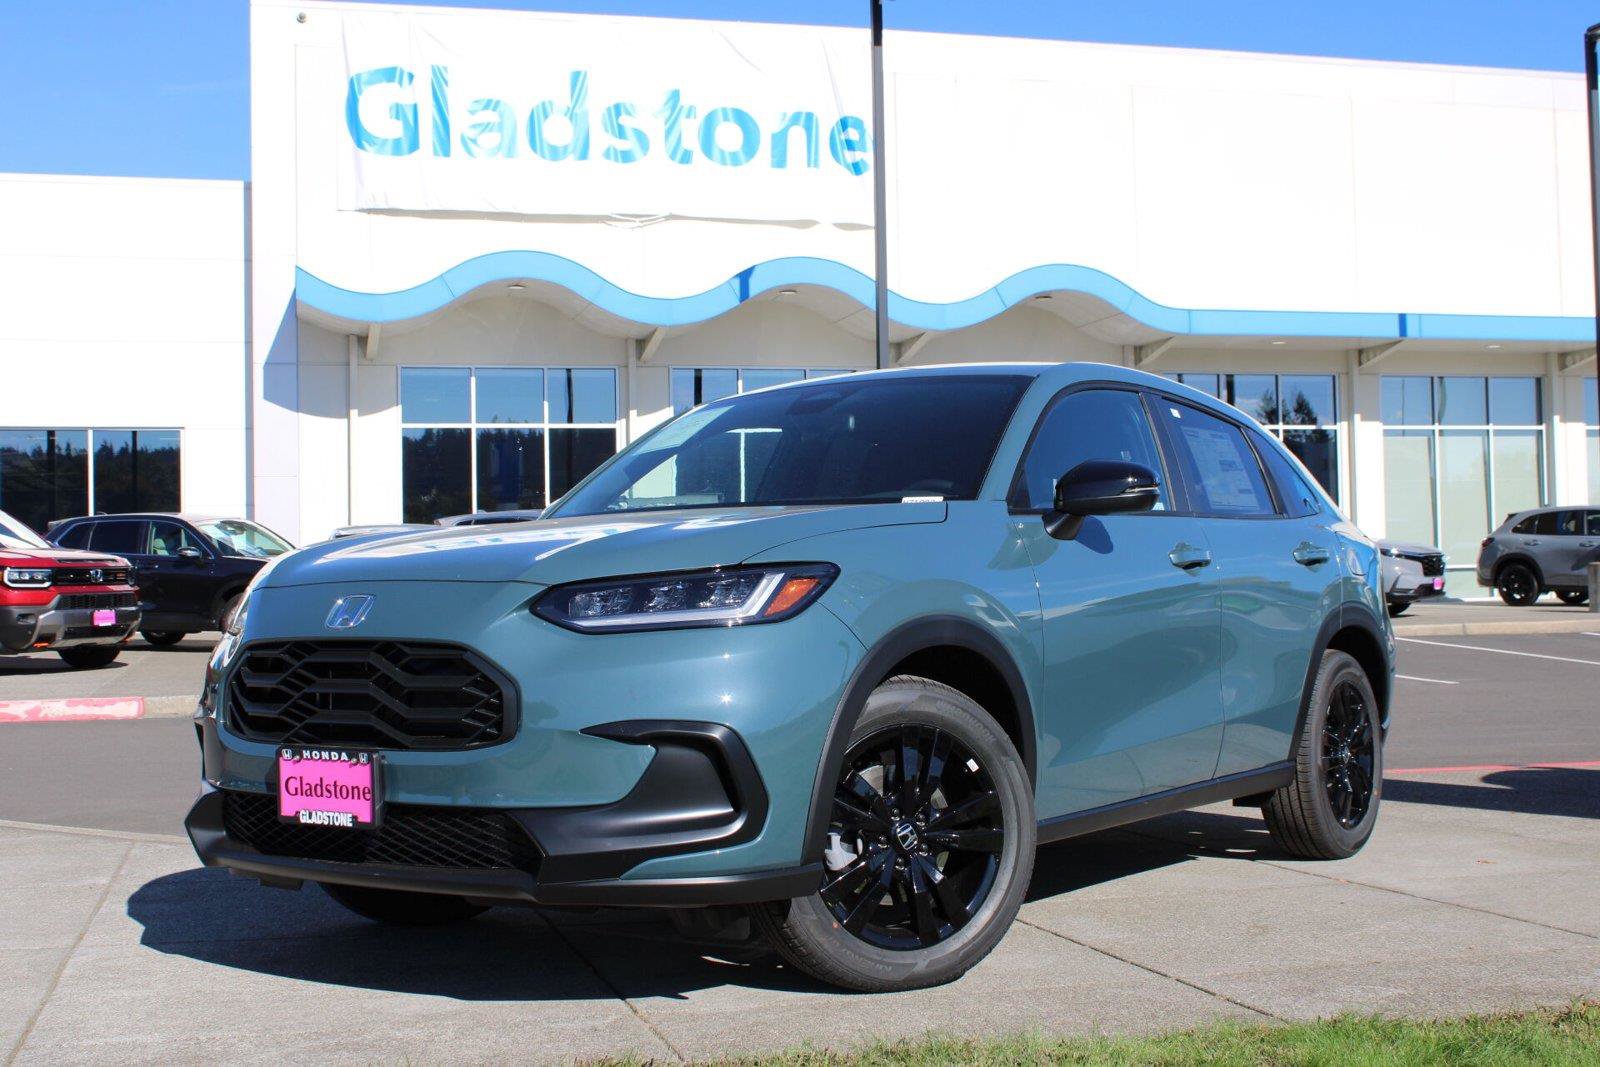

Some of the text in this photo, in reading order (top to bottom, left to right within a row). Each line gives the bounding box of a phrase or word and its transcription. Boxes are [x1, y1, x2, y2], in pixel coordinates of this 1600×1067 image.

[345, 64, 870, 176] Gladstone
[302, 750, 349, 761] HONDA
[284, 776, 371, 801] Gladstone
[299, 809, 353, 827] GLADSTONE
